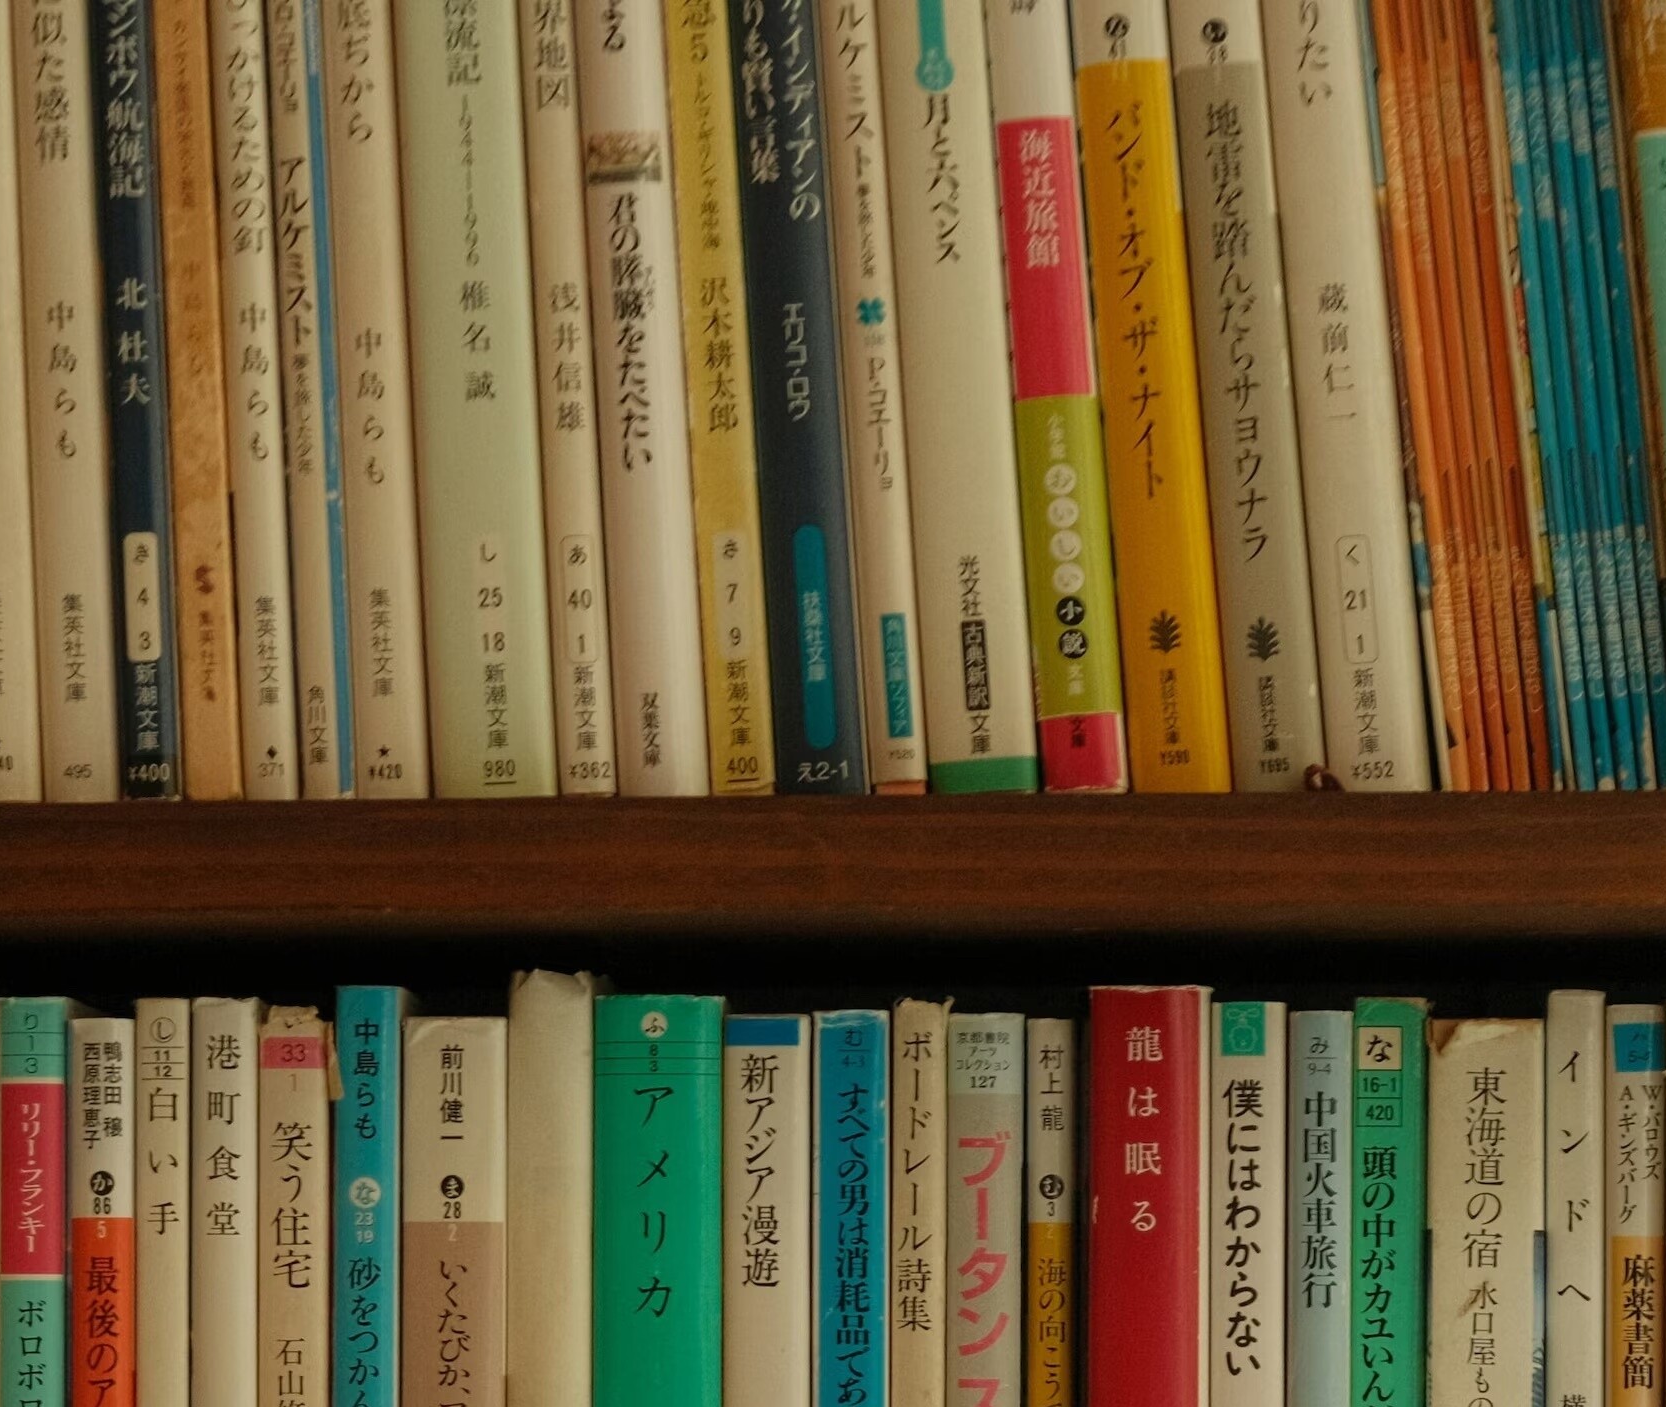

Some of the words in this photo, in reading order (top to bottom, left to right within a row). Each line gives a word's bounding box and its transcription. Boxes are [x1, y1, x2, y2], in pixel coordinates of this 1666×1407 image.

[278, 156, 314, 346] アルケミスト
[922, 95, 963, 266] 月と六ペンス
[1017, 128, 1062, 270] 海近旅館
[115, 276, 154, 408] 北杜夫
[459, 280, 496, 403] 椎名誠
[550, 281, 588, 434] 浅井信雄
[699, 277, 740, 434] 沢木耕太郎
[1104, 100, 1165, 500] バンド・オブ・ザ・ナイト
[1203, 100, 1271, 564] 地雷を踏んだらサヨウナラ
[477, 588, 505, 610] 25
[483, 759, 517, 778] 980
[484, 663, 511, 750] 新潮文庫
[1349, 760, 1395, 781] ¥552
[82, 1040, 103, 1151] 西原理恵子
[147, 1086, 181, 1238] 白い手
[205, 1034, 244, 1238] 港町食堂
[439, 1043, 466, 1142] 前川健一
[739, 1052, 782, 1290] 新アジア漫遊
[1123, 1023, 1166, 1235] 龍は眠る
[1463, 1067, 1507, 1270] 東海道の宿
[18, 1102, 48, 1255] リリー・フランキー
[271, 1120, 313, 1291] 笑う住宅
[632, 1083, 676, 1320] アメリカ
[895, 1028, 934, 1333] ボードレール詩集
[1223, 1078, 1267, 1379] 僕にはわからない
[1300, 1091, 1340, 1311] 中国火車旅行
[1556, 1050, 1592, 1306] インドへ
[1621, 1254, 1656, 1390] 麻薬書簡
